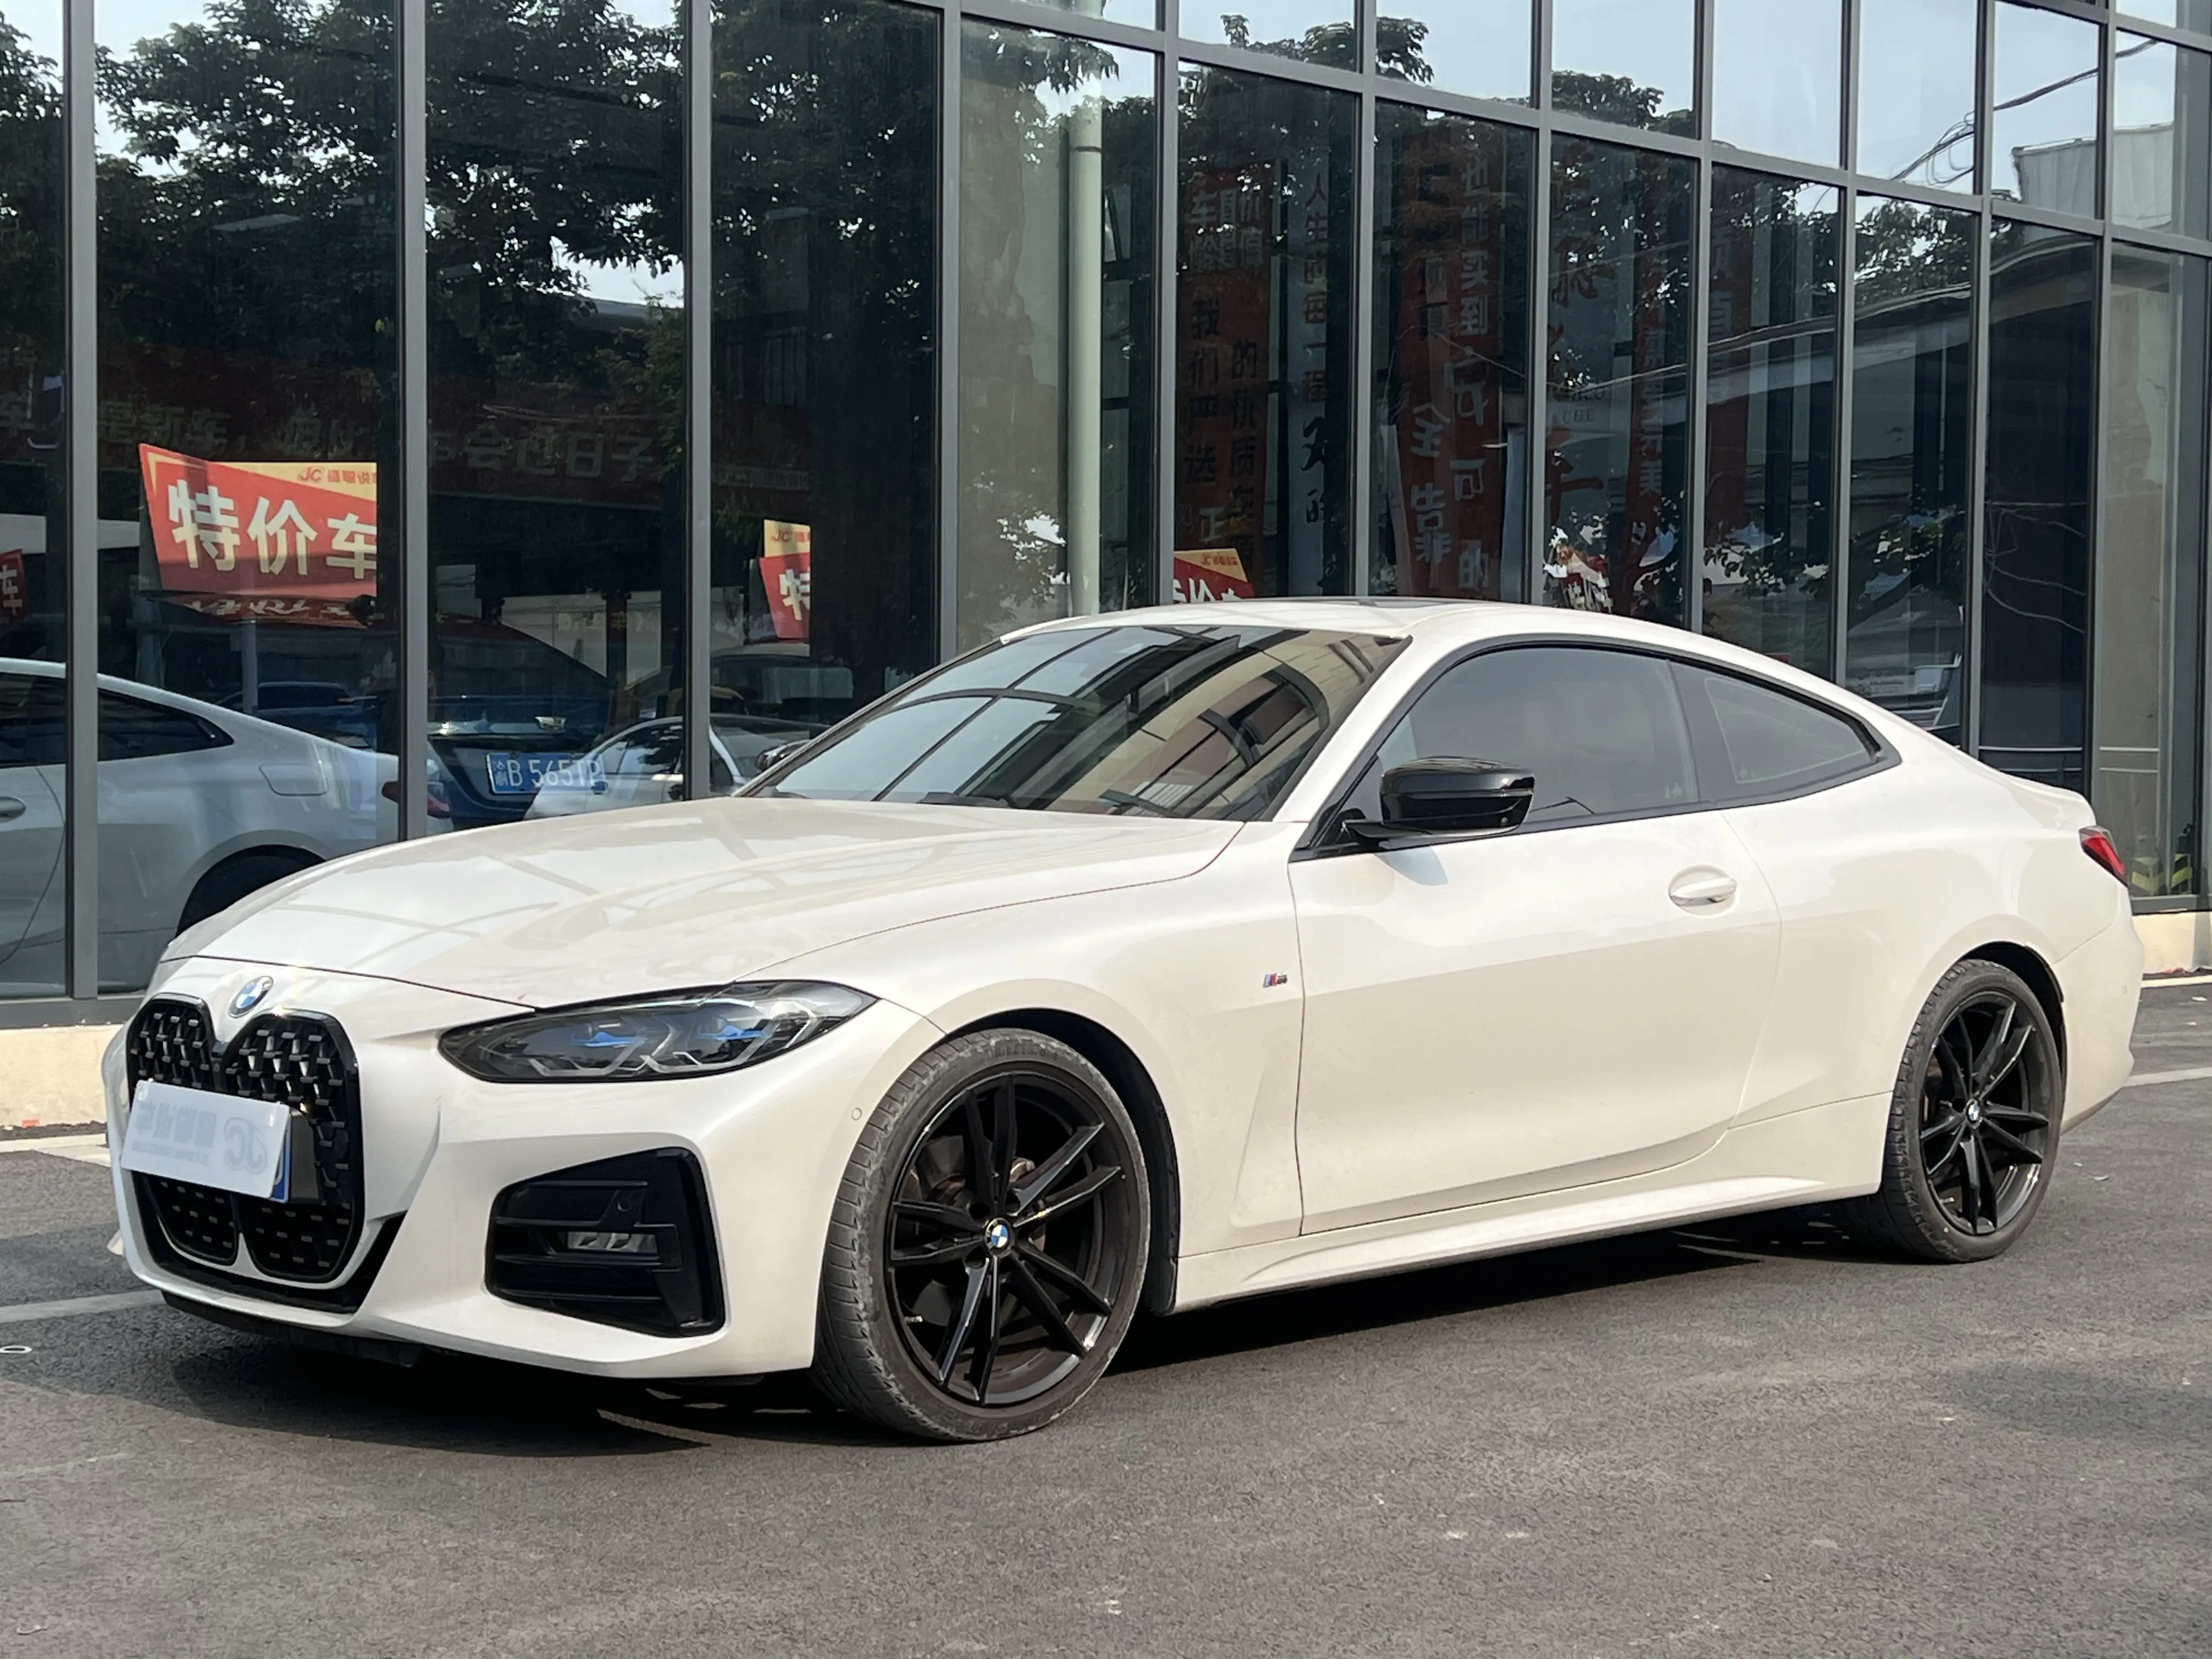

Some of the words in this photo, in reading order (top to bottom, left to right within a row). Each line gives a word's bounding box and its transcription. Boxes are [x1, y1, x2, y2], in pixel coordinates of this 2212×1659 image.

[300, 466, 323, 482] JC
[168, 479, 377, 579] 特价车
